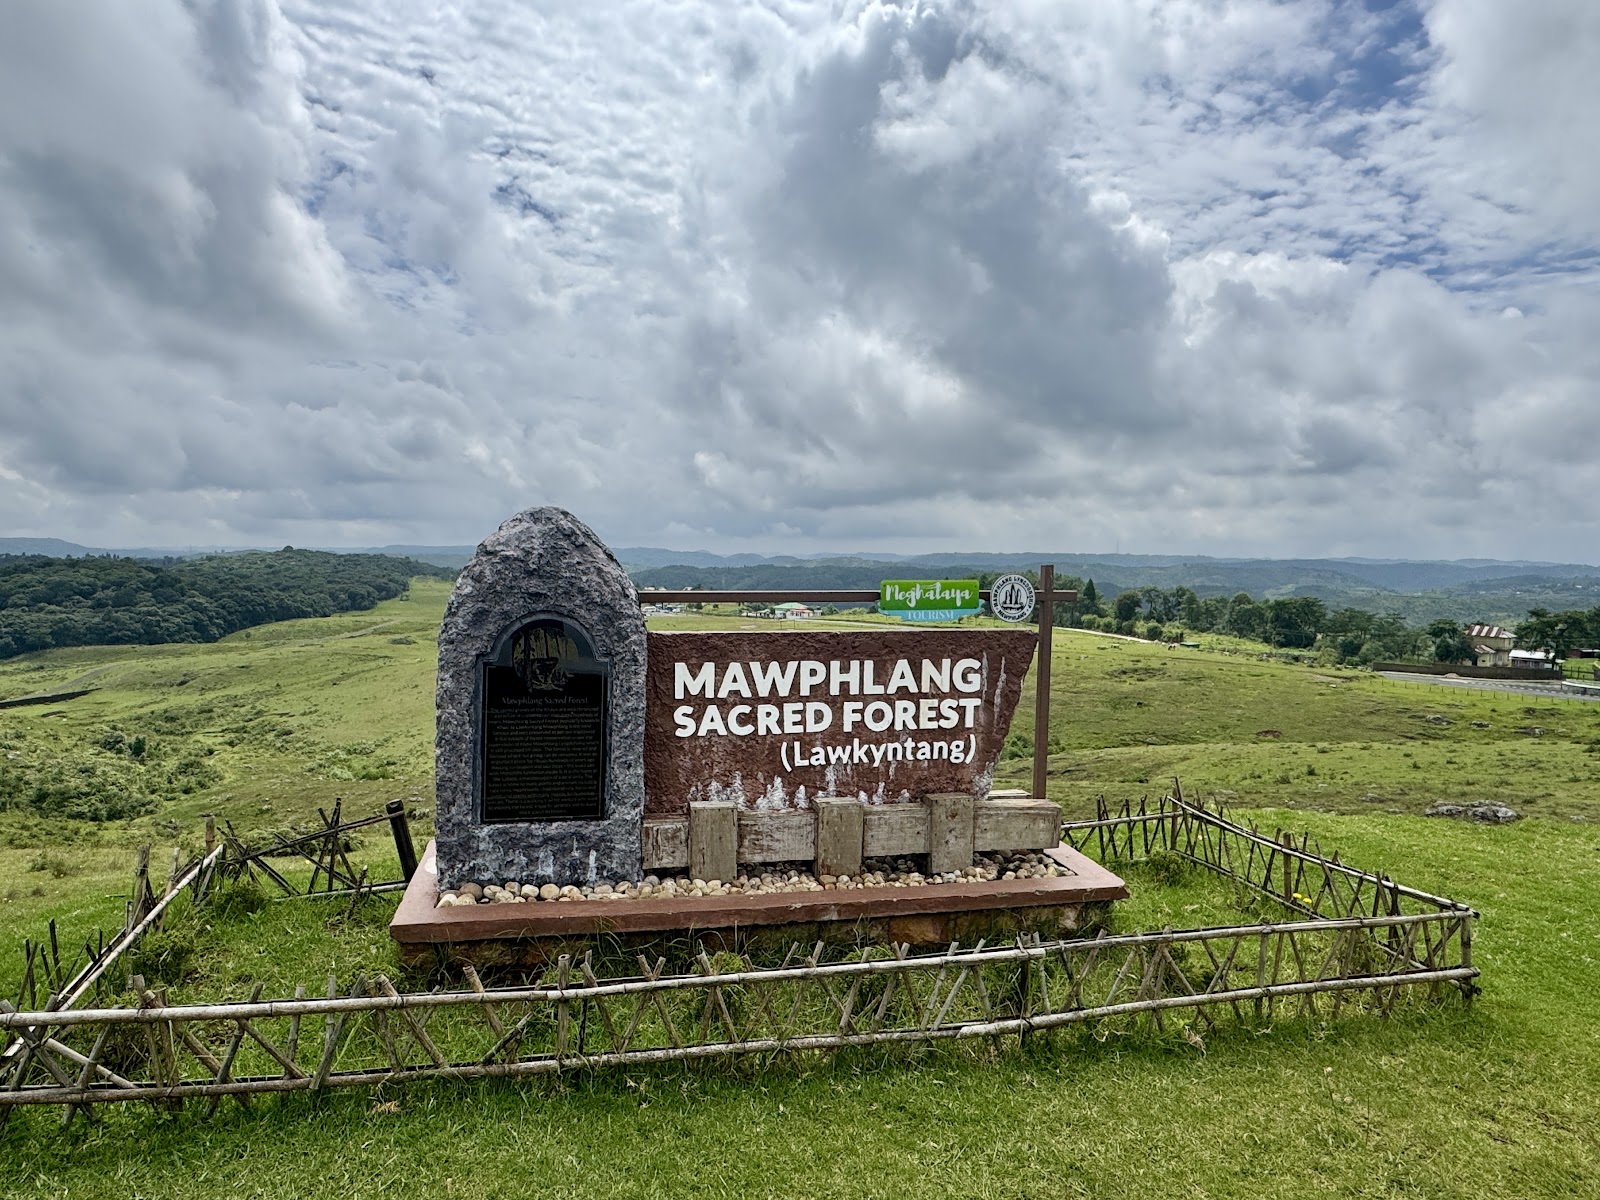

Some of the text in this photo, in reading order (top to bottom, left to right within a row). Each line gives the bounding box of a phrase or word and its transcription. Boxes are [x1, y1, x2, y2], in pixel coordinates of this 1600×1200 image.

[885, 581, 973, 607] Meghalaya
[906, 610, 955, 620] TOURISM
[674, 658, 982, 700] MAWPHLANG
[502, 695, 588, 706] Mawphlang Sacred Forest
[673, 698, 981, 738] SACRED FOREST
[780, 734, 976, 772] (Lawkyntang)
